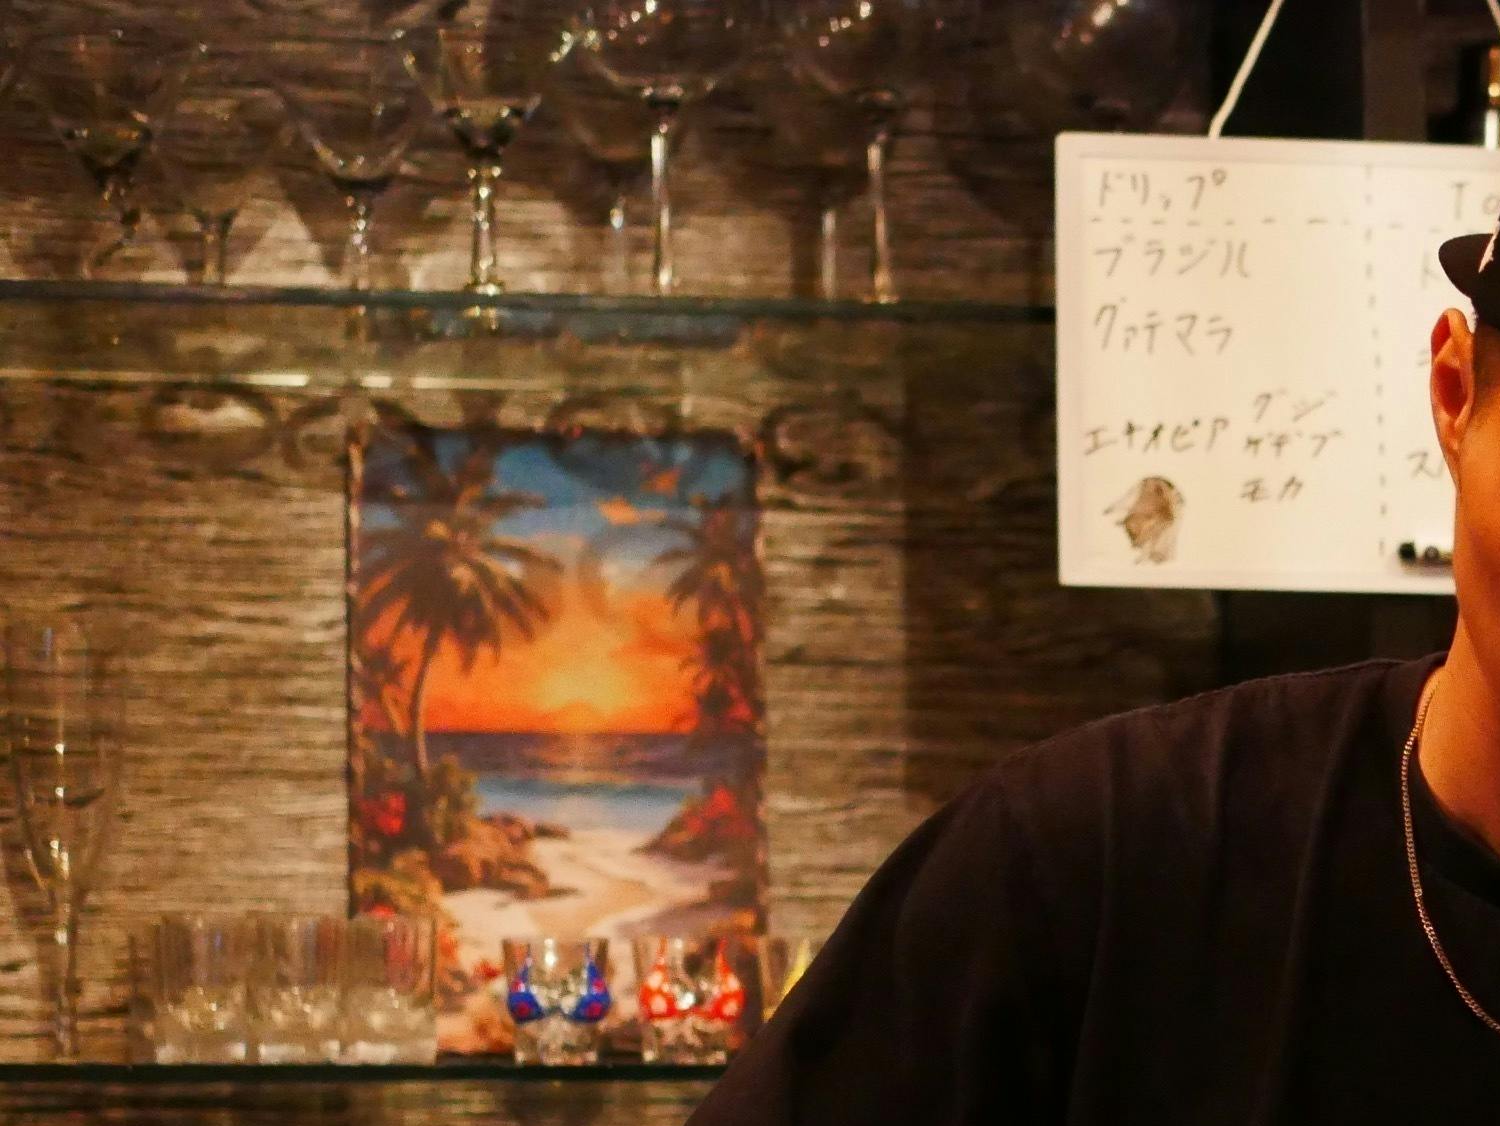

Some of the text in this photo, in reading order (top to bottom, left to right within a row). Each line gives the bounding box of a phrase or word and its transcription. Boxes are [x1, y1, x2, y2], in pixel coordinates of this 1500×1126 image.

[1093, 233, 1252, 279] ブラジル
[1094, 296, 1234, 356] グァテマラ
